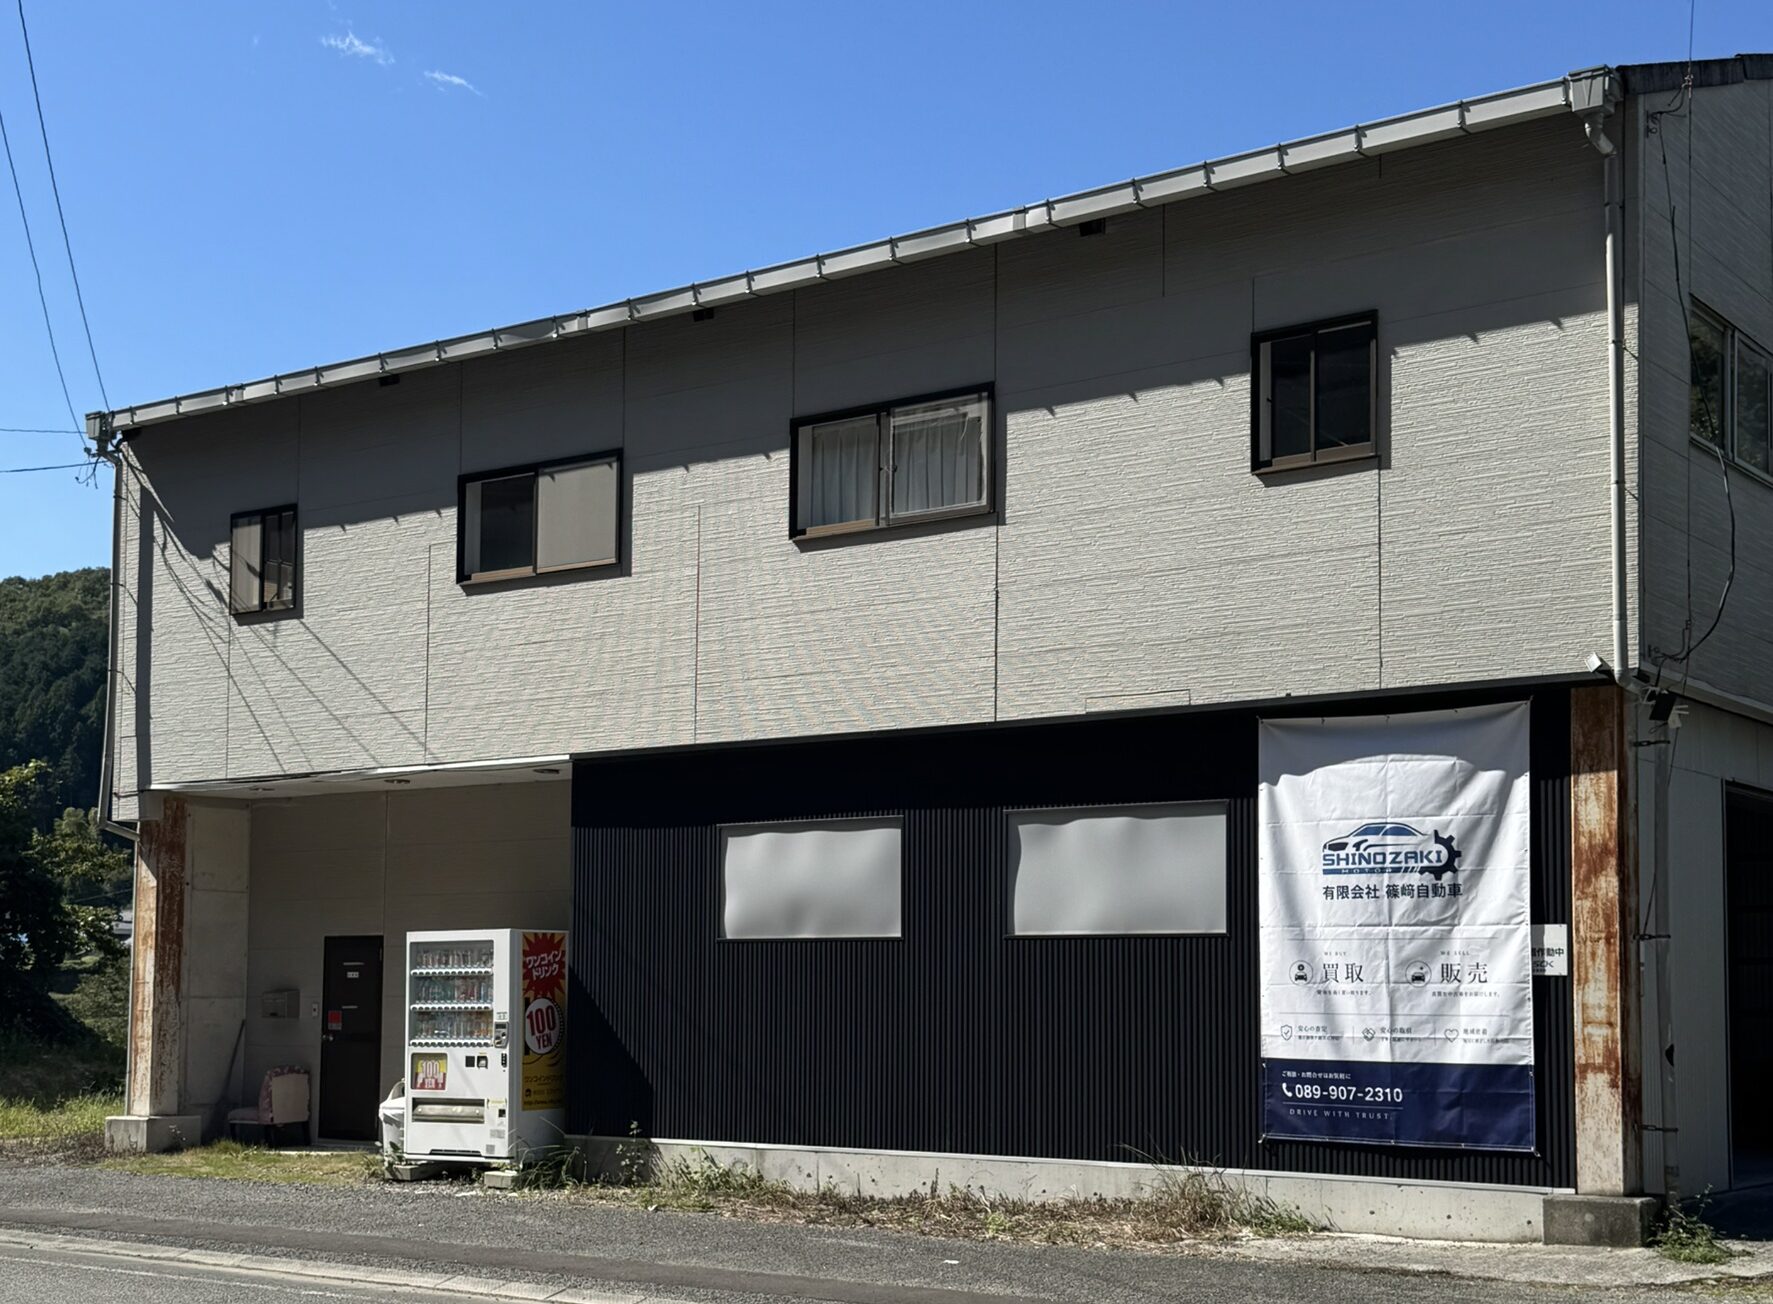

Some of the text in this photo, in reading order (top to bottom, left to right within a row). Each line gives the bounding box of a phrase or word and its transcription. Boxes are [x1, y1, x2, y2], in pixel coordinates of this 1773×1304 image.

[1322, 850, 1443, 866] SHINOZAKI
[1322, 884, 1380, 900] 有限会社
[526, 950, 563, 969] ワンコイン
[531, 964, 560, 981] ドリンク
[1321, 962, 1364, 984] 買取
[1440, 962, 1488, 984] 販売
[527, 1005, 556, 1037] 100
[535, 1033, 553, 1051] YEN
[422, 1060, 439, 1079] 100
[1295, 1083, 1403, 1103] 089-907-2310
[1289, 1108, 1319, 1117] DRIVE
[1323, 1110, 1350, 1119] WITH
